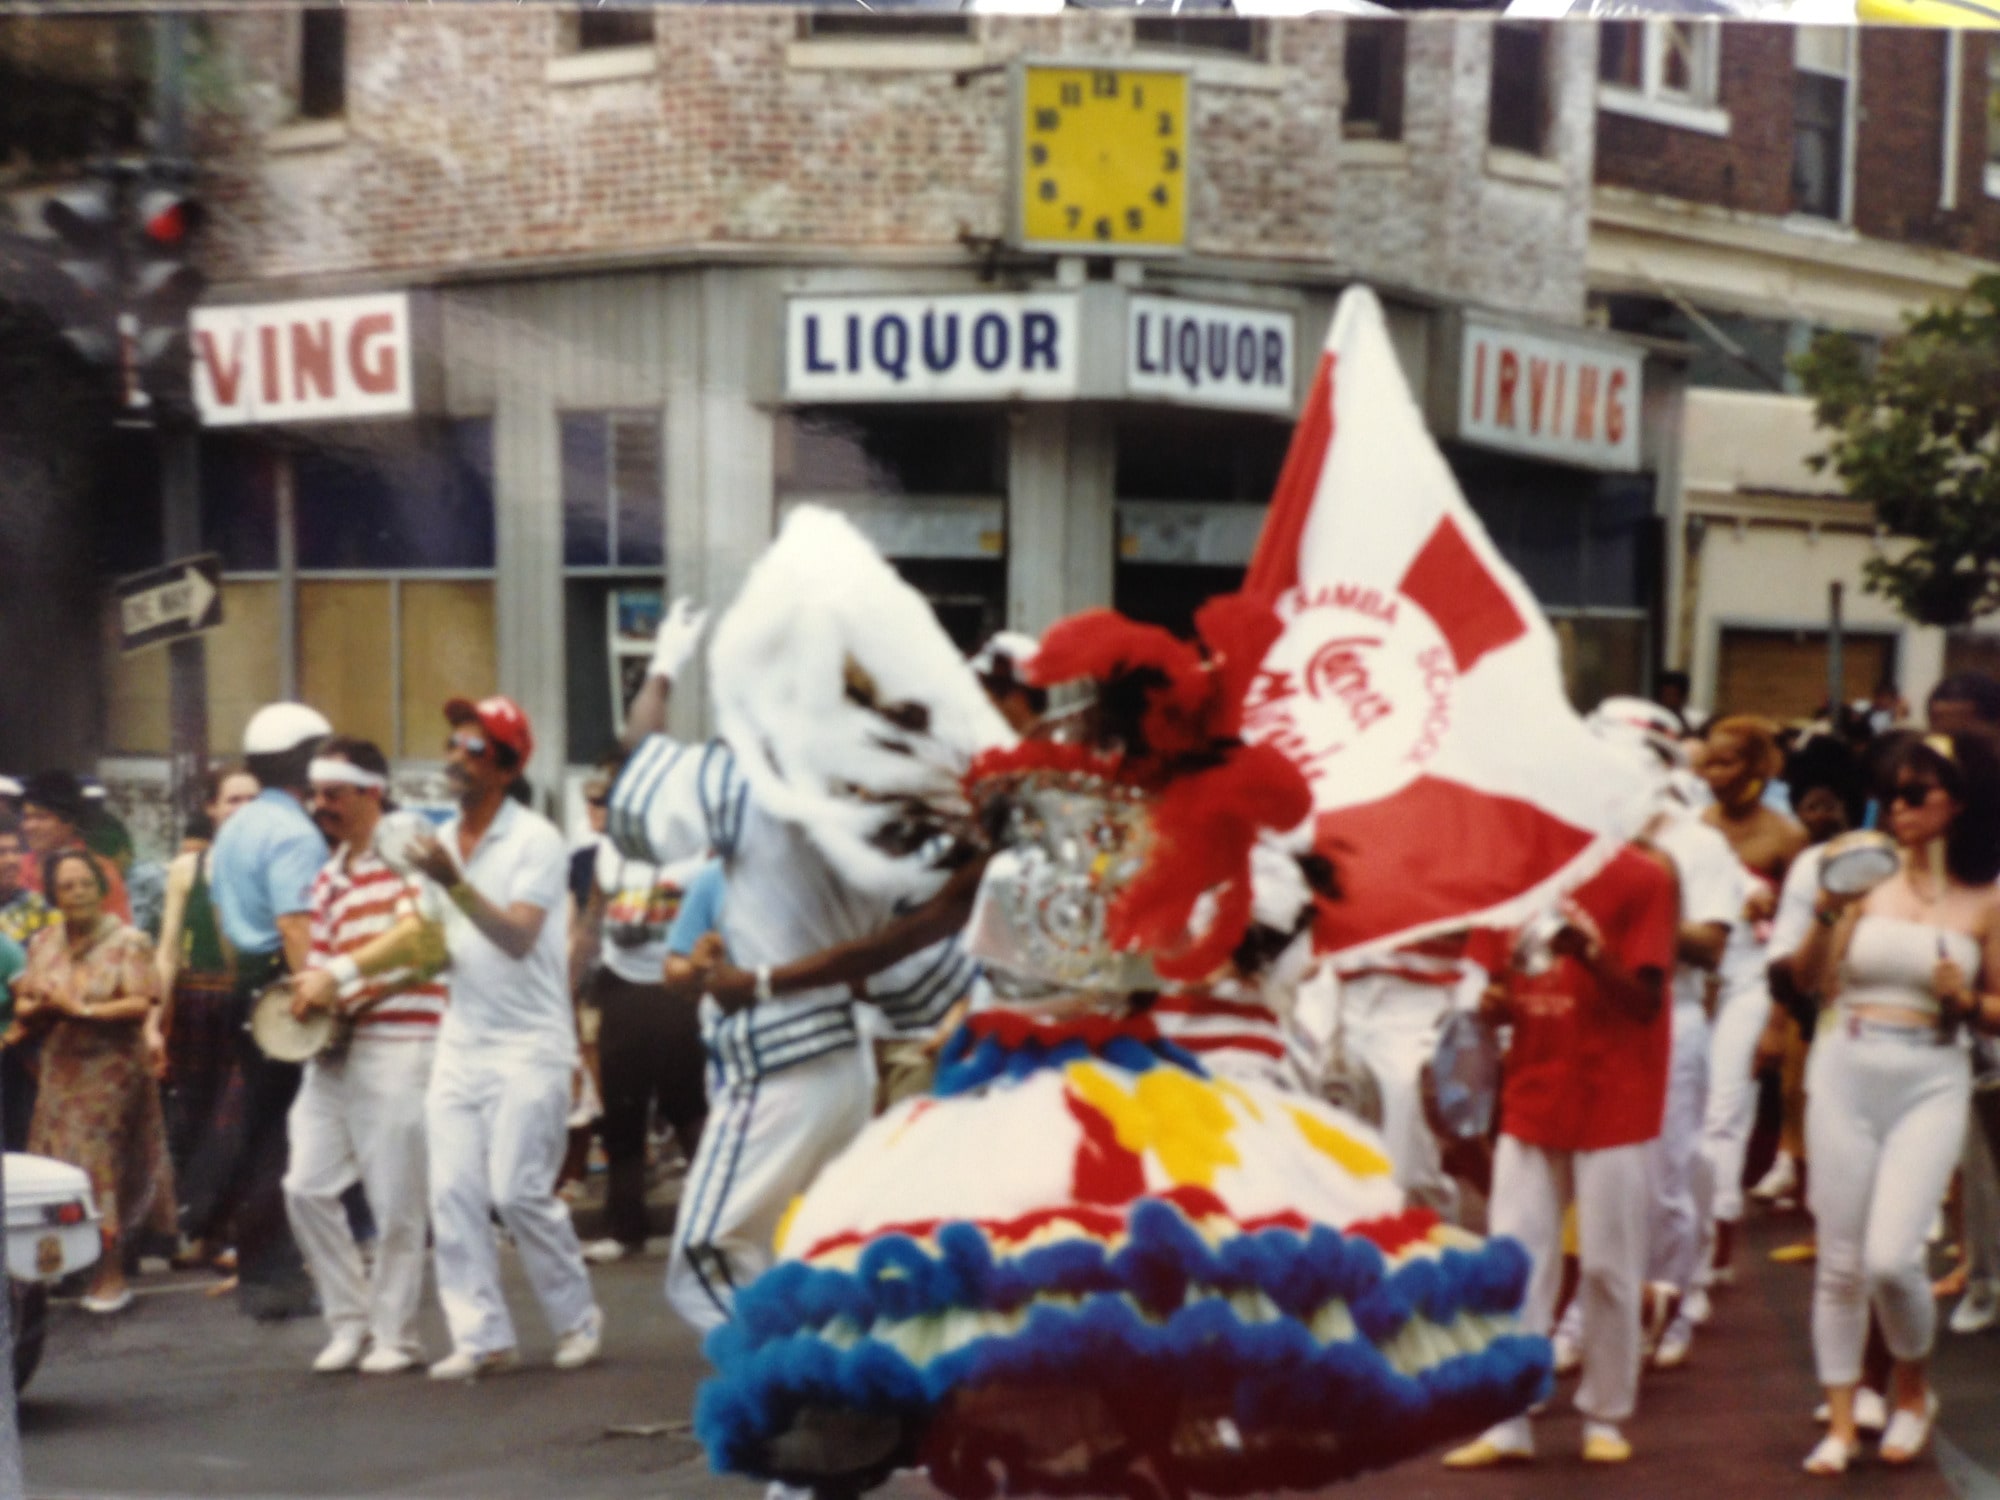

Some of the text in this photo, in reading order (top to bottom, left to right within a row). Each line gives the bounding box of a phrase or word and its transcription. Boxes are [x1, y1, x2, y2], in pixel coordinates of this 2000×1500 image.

[195, 312, 398, 407] VING
[803, 309, 1062, 382] LIQUOR
[1134, 311, 1286, 389] LIQUOR
[1471, 339, 1628, 447] IRVING
